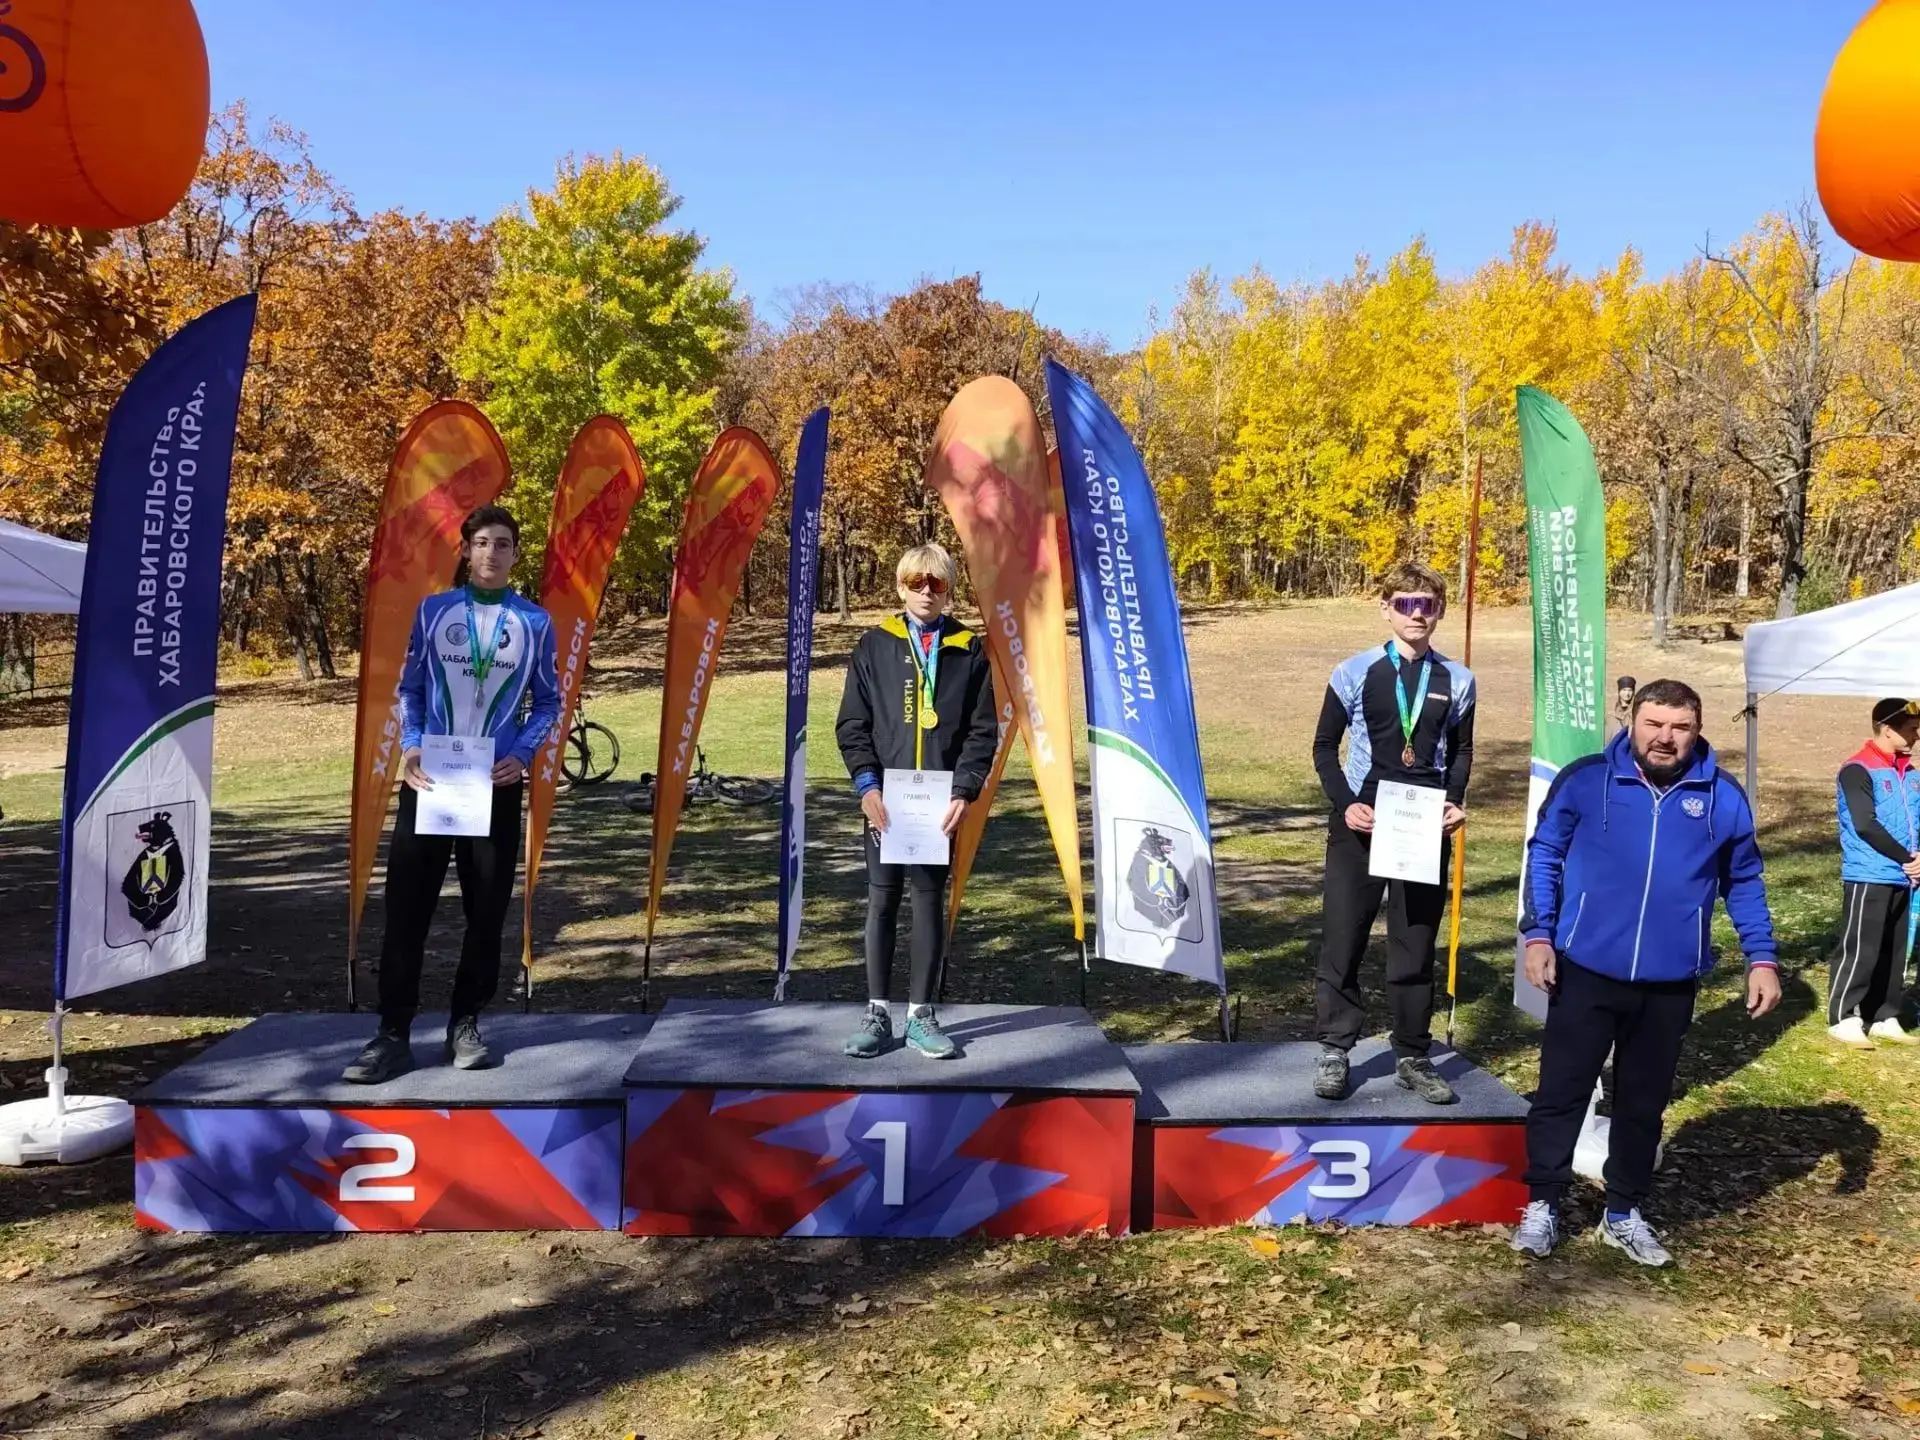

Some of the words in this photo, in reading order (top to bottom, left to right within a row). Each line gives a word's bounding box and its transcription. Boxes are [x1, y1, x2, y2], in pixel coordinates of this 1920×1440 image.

[134, 407, 180, 656] ПРАВИТЕЛЬСТВО
[159, 459, 197, 687] ХАБАРОВСКОГО
[441, 653, 515, 670] ХАБАРСКИЙ
[905, 655, 912, 664] N
[673, 617, 719, 775] ХАБАРОВСК
[904, 679, 913, 723] NORTH
[339, 1133, 416, 1202] 2
[862, 1121, 907, 1205] 1
[1307, 1140, 1371, 1198] 3
